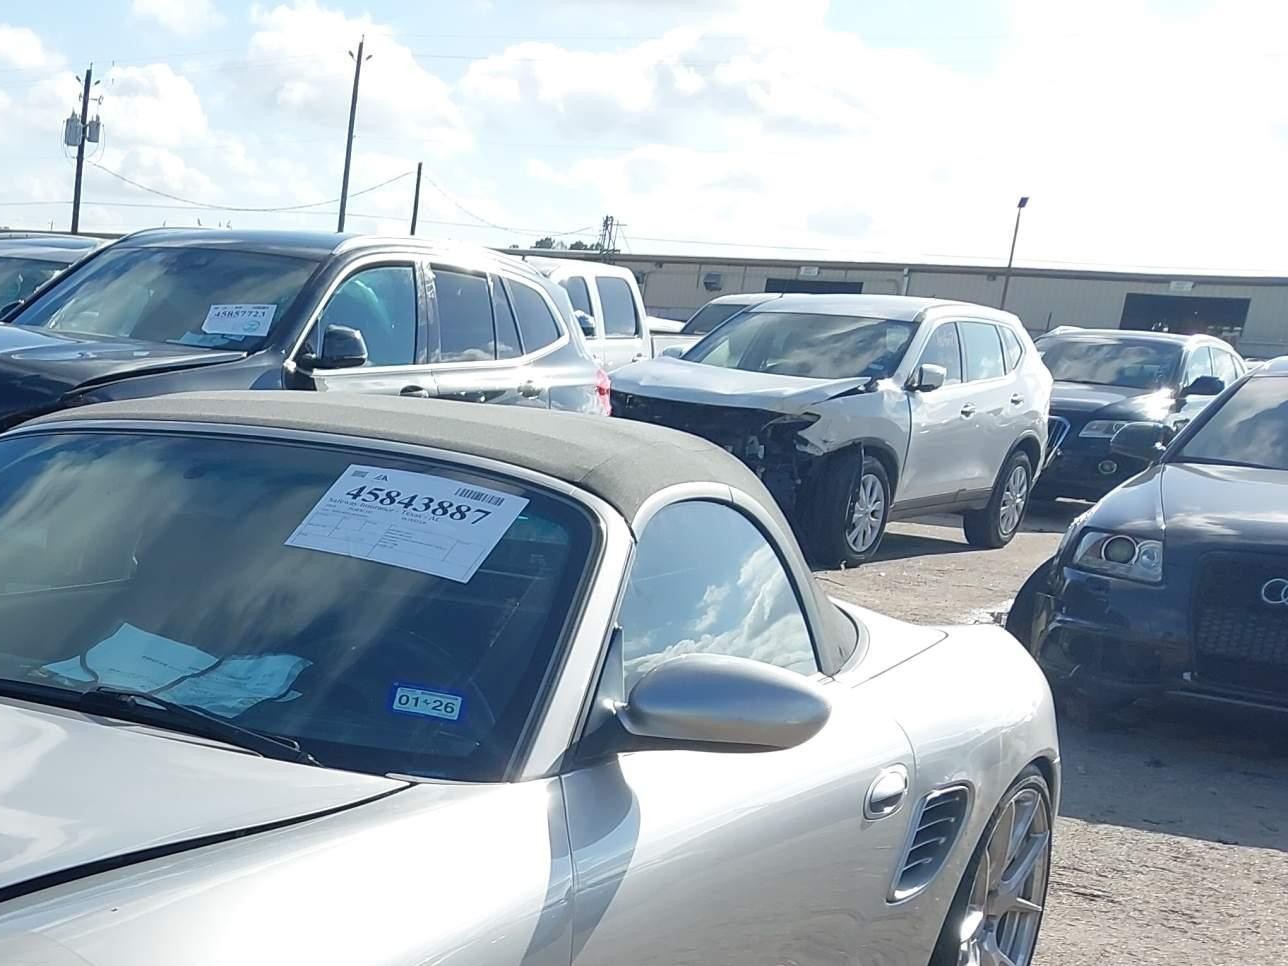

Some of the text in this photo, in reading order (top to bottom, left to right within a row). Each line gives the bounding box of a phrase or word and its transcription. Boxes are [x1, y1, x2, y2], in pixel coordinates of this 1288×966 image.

[346, 485, 492, 525] 45843887
[398, 694, 419, 707] 01
[431, 699, 456, 714] 26
